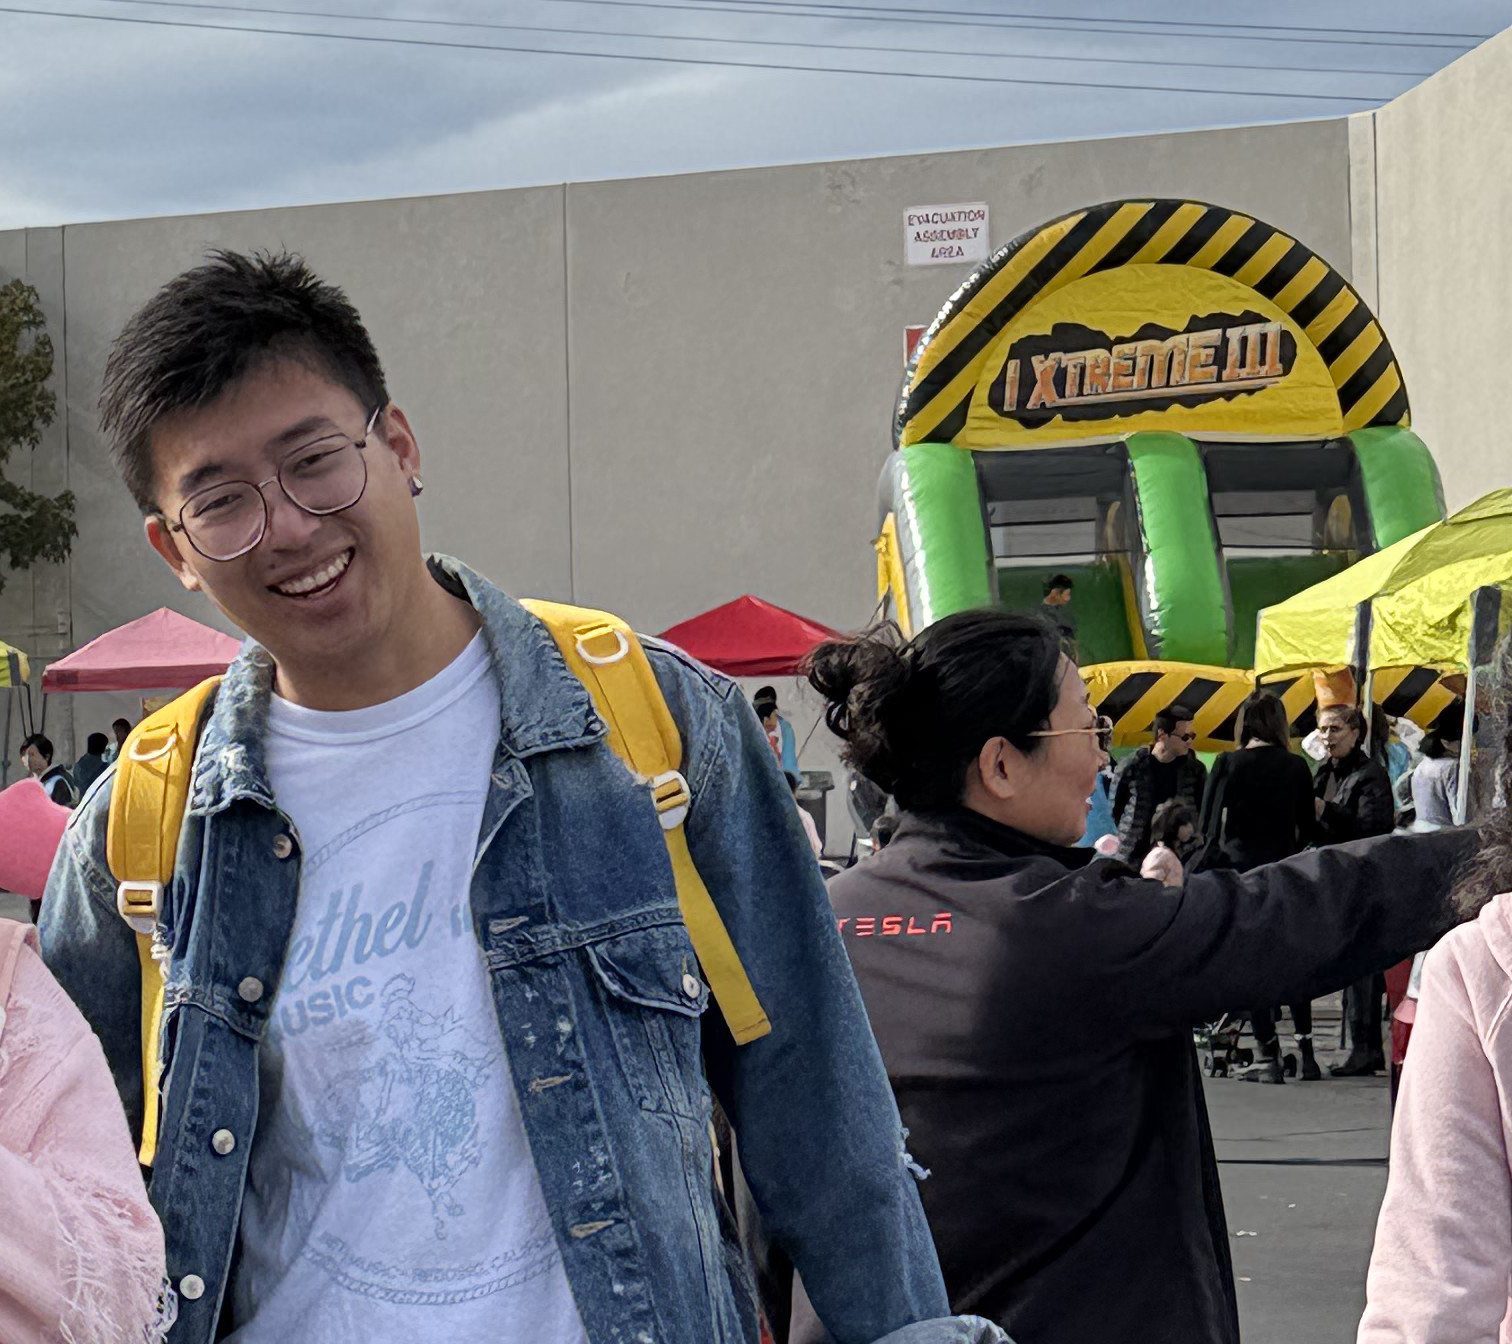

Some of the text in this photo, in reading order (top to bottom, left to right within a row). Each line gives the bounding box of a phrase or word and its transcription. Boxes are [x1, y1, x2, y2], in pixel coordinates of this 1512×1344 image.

[1026, 328, 1222, 410] XTREME
[285, 859, 434, 993] ethel
[280, 975, 375, 1036] USIC
